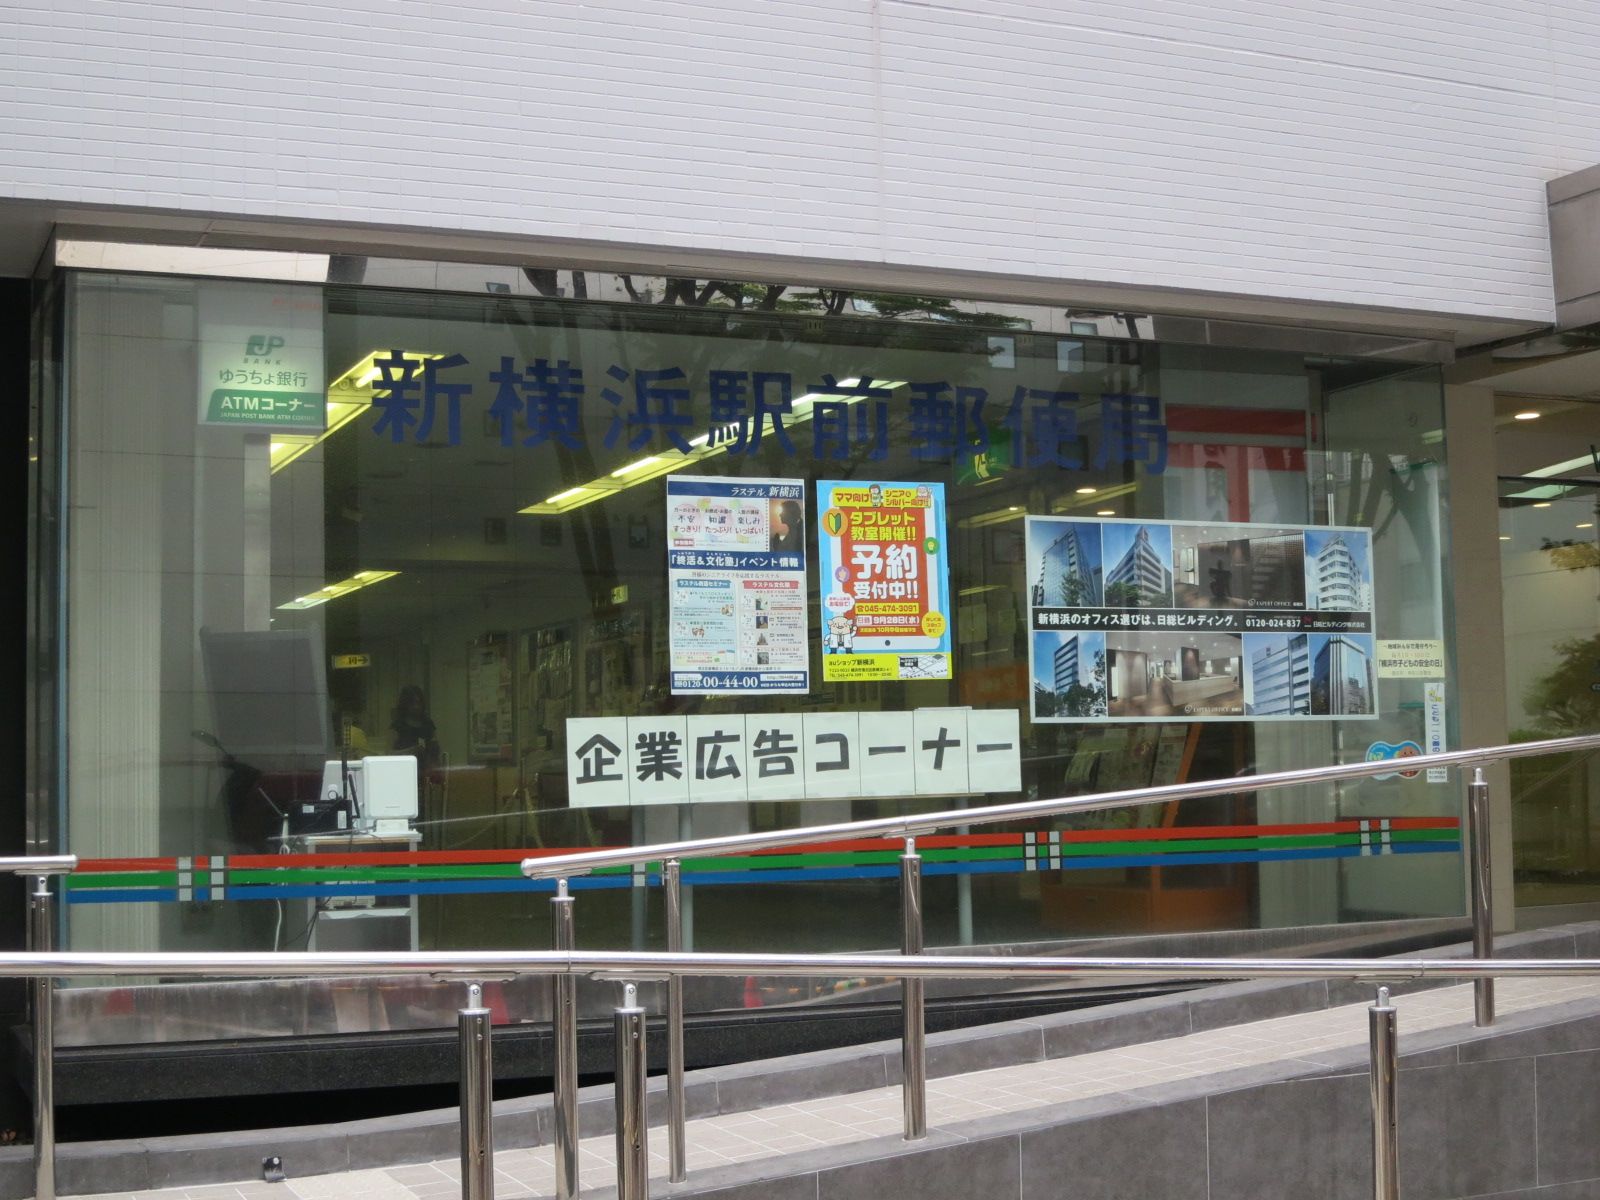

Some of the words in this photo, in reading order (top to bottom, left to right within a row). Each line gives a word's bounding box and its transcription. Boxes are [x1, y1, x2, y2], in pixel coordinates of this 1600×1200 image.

[245, 335, 285, 356] JP
[219, 369, 308, 388] ゆうちょ銀行
[221, 397, 316, 412] ATMコーナー
[372, 350, 1168, 476] 新横浜駅前郵便局
[850, 511, 916, 525] タブレット
[851, 526, 917, 541] 教室開催!!
[851, 544, 918, 580] 予約
[853, 581, 919, 600] 受付中!!
[873, 615, 920, 624] 9月28日(水)
[1038, 612, 1238, 627] 新横浜のオフィス選びは、日総ビルディング。
[1245, 618, 1301, 628] 0120-024-837
[574, 727, 1014, 785] 企業広告コーナー
